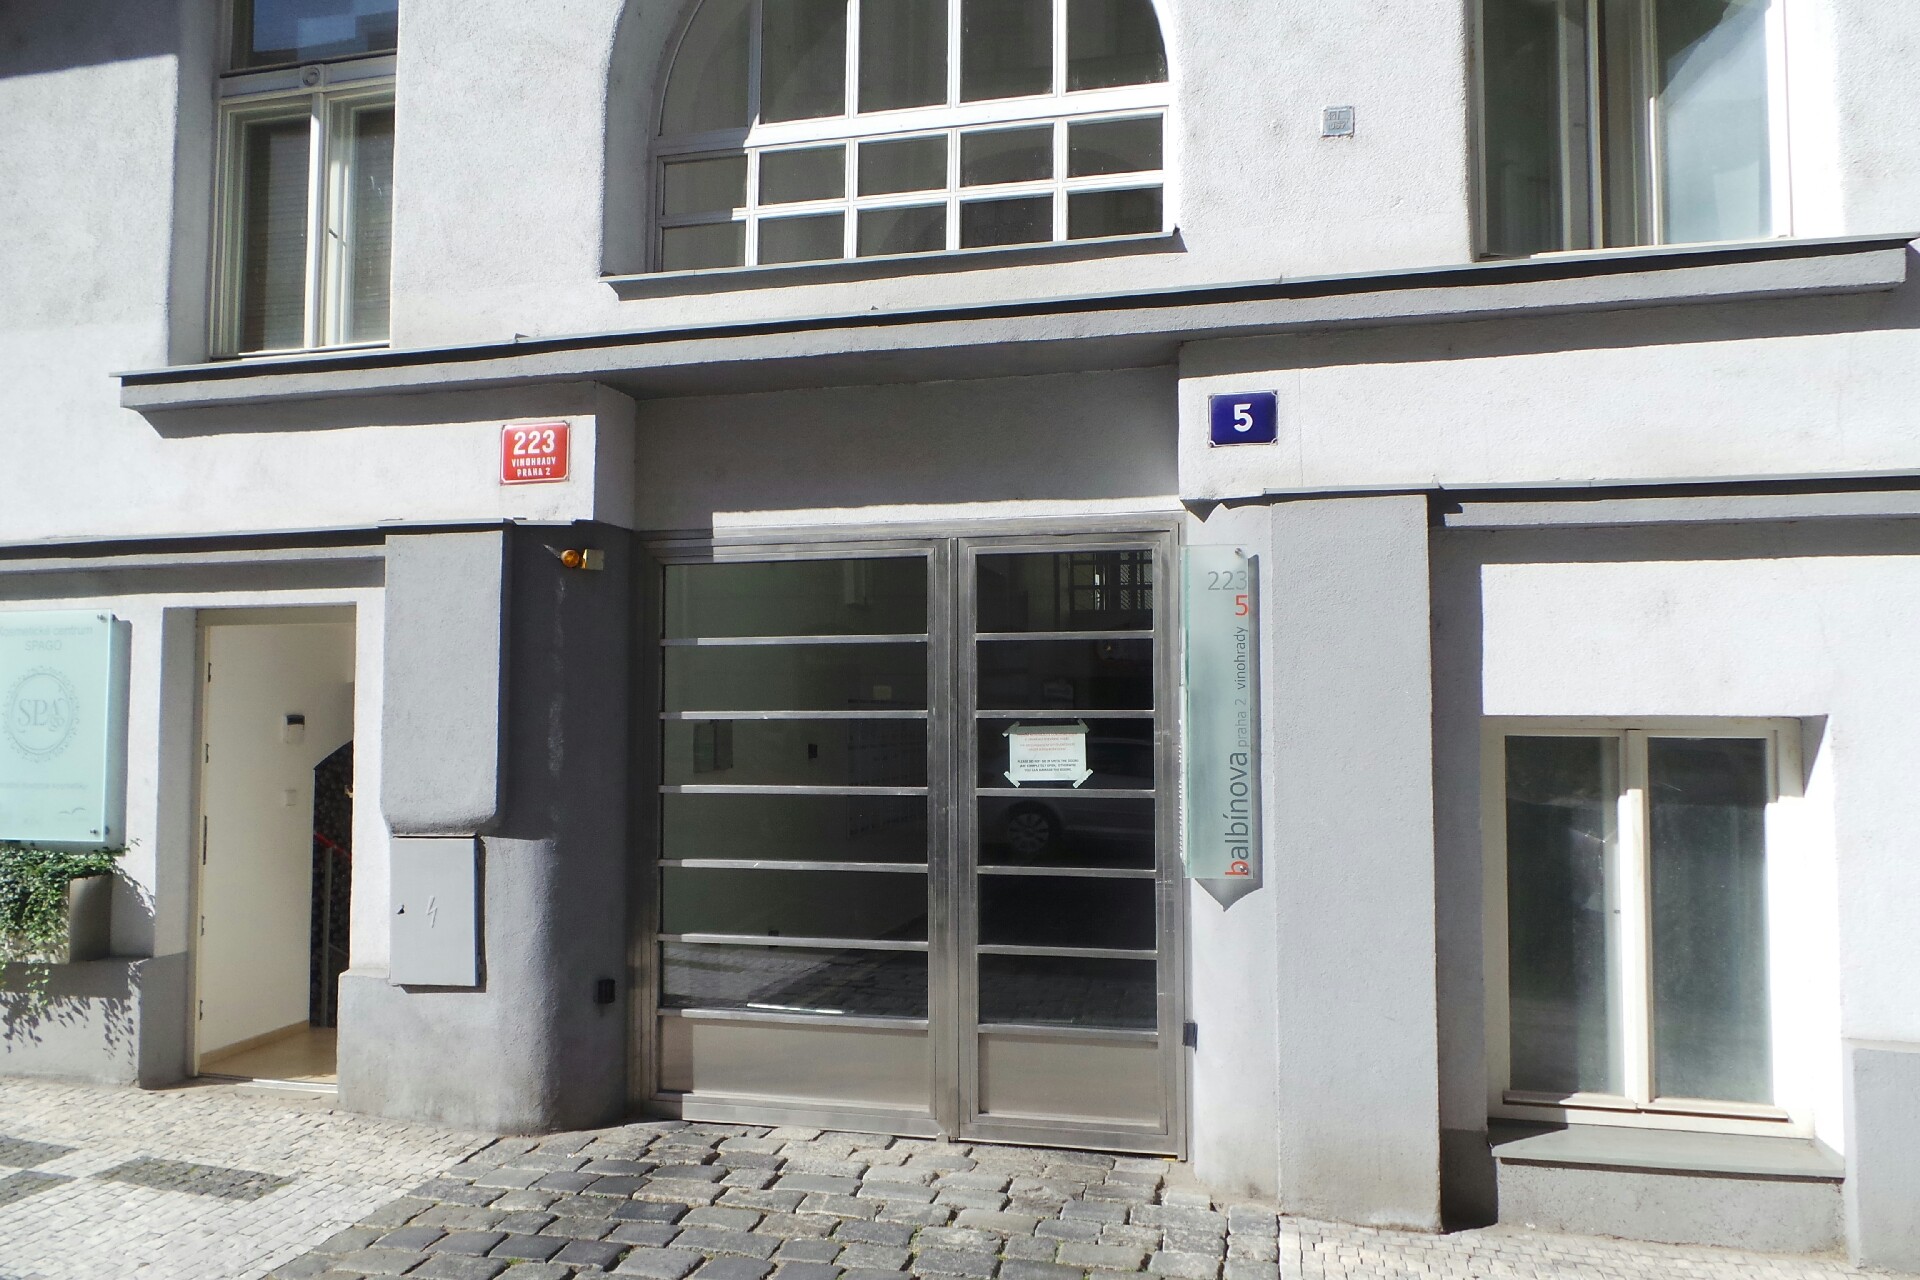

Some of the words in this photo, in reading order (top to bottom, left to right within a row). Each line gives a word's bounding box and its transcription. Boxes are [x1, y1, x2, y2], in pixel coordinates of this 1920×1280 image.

[1233, 403, 1253, 432] 5
[513, 429, 555, 455] 223
[511, 456, 556, 467] VINOHRADY
[516, 467, 543, 477] PRAHA
[545, 467, 551, 476] 2
[1207, 570, 1247, 590] 223
[1235, 594, 1249, 616] 5
[25, 639, 62, 651] SPAGO
[1233, 626, 1248, 690] vinohrady
[1235, 698, 1247, 706] 2
[1235, 711, 1249, 748] praha
[1223, 752, 1249, 876] balbínova
